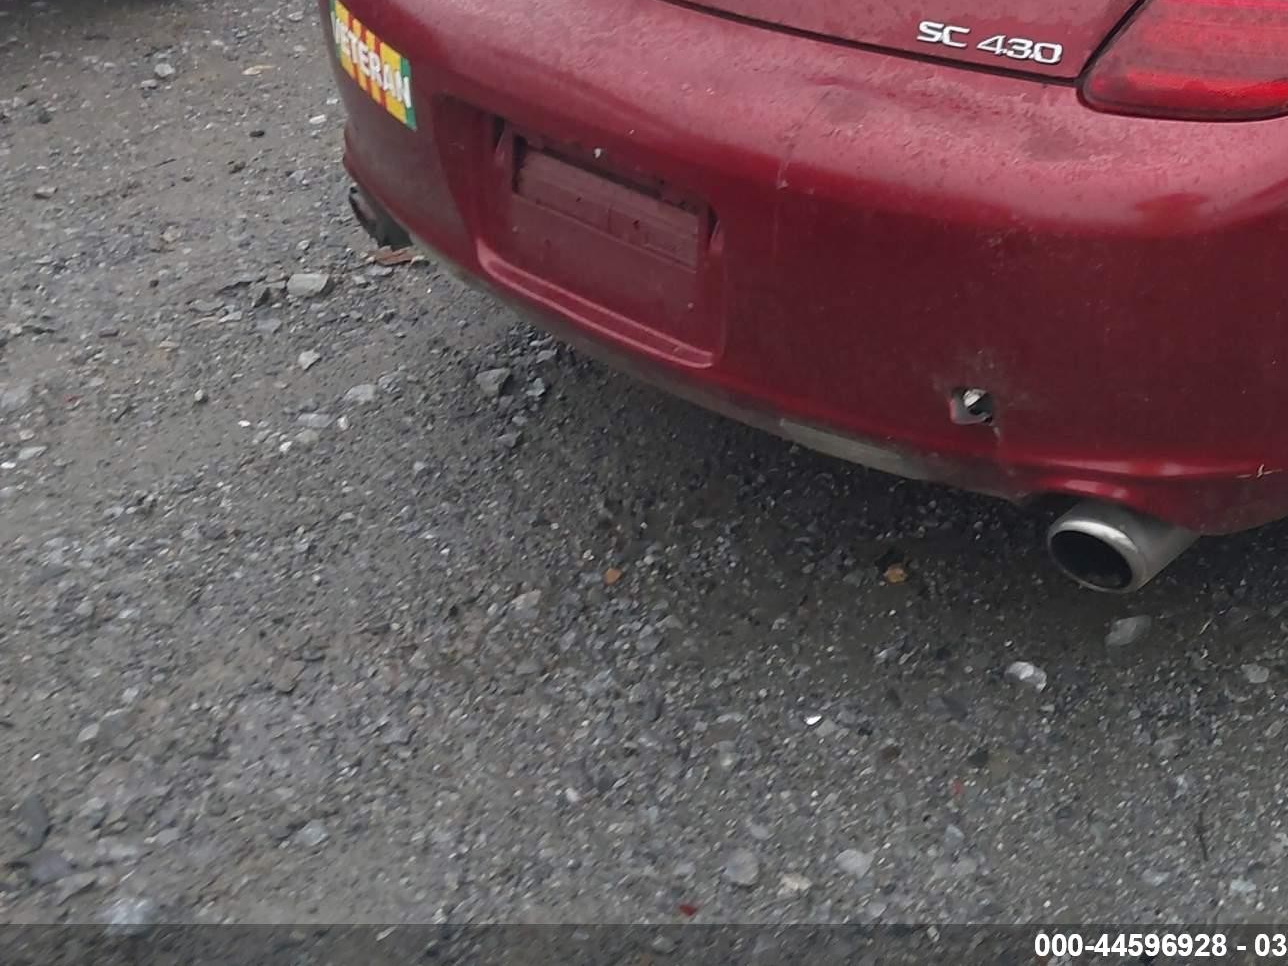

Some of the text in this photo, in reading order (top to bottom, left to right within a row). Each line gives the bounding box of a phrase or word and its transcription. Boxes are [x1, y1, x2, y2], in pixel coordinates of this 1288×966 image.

[330, 10, 412, 108] VETERAN
[916, 20, 1063, 64] SC 430
